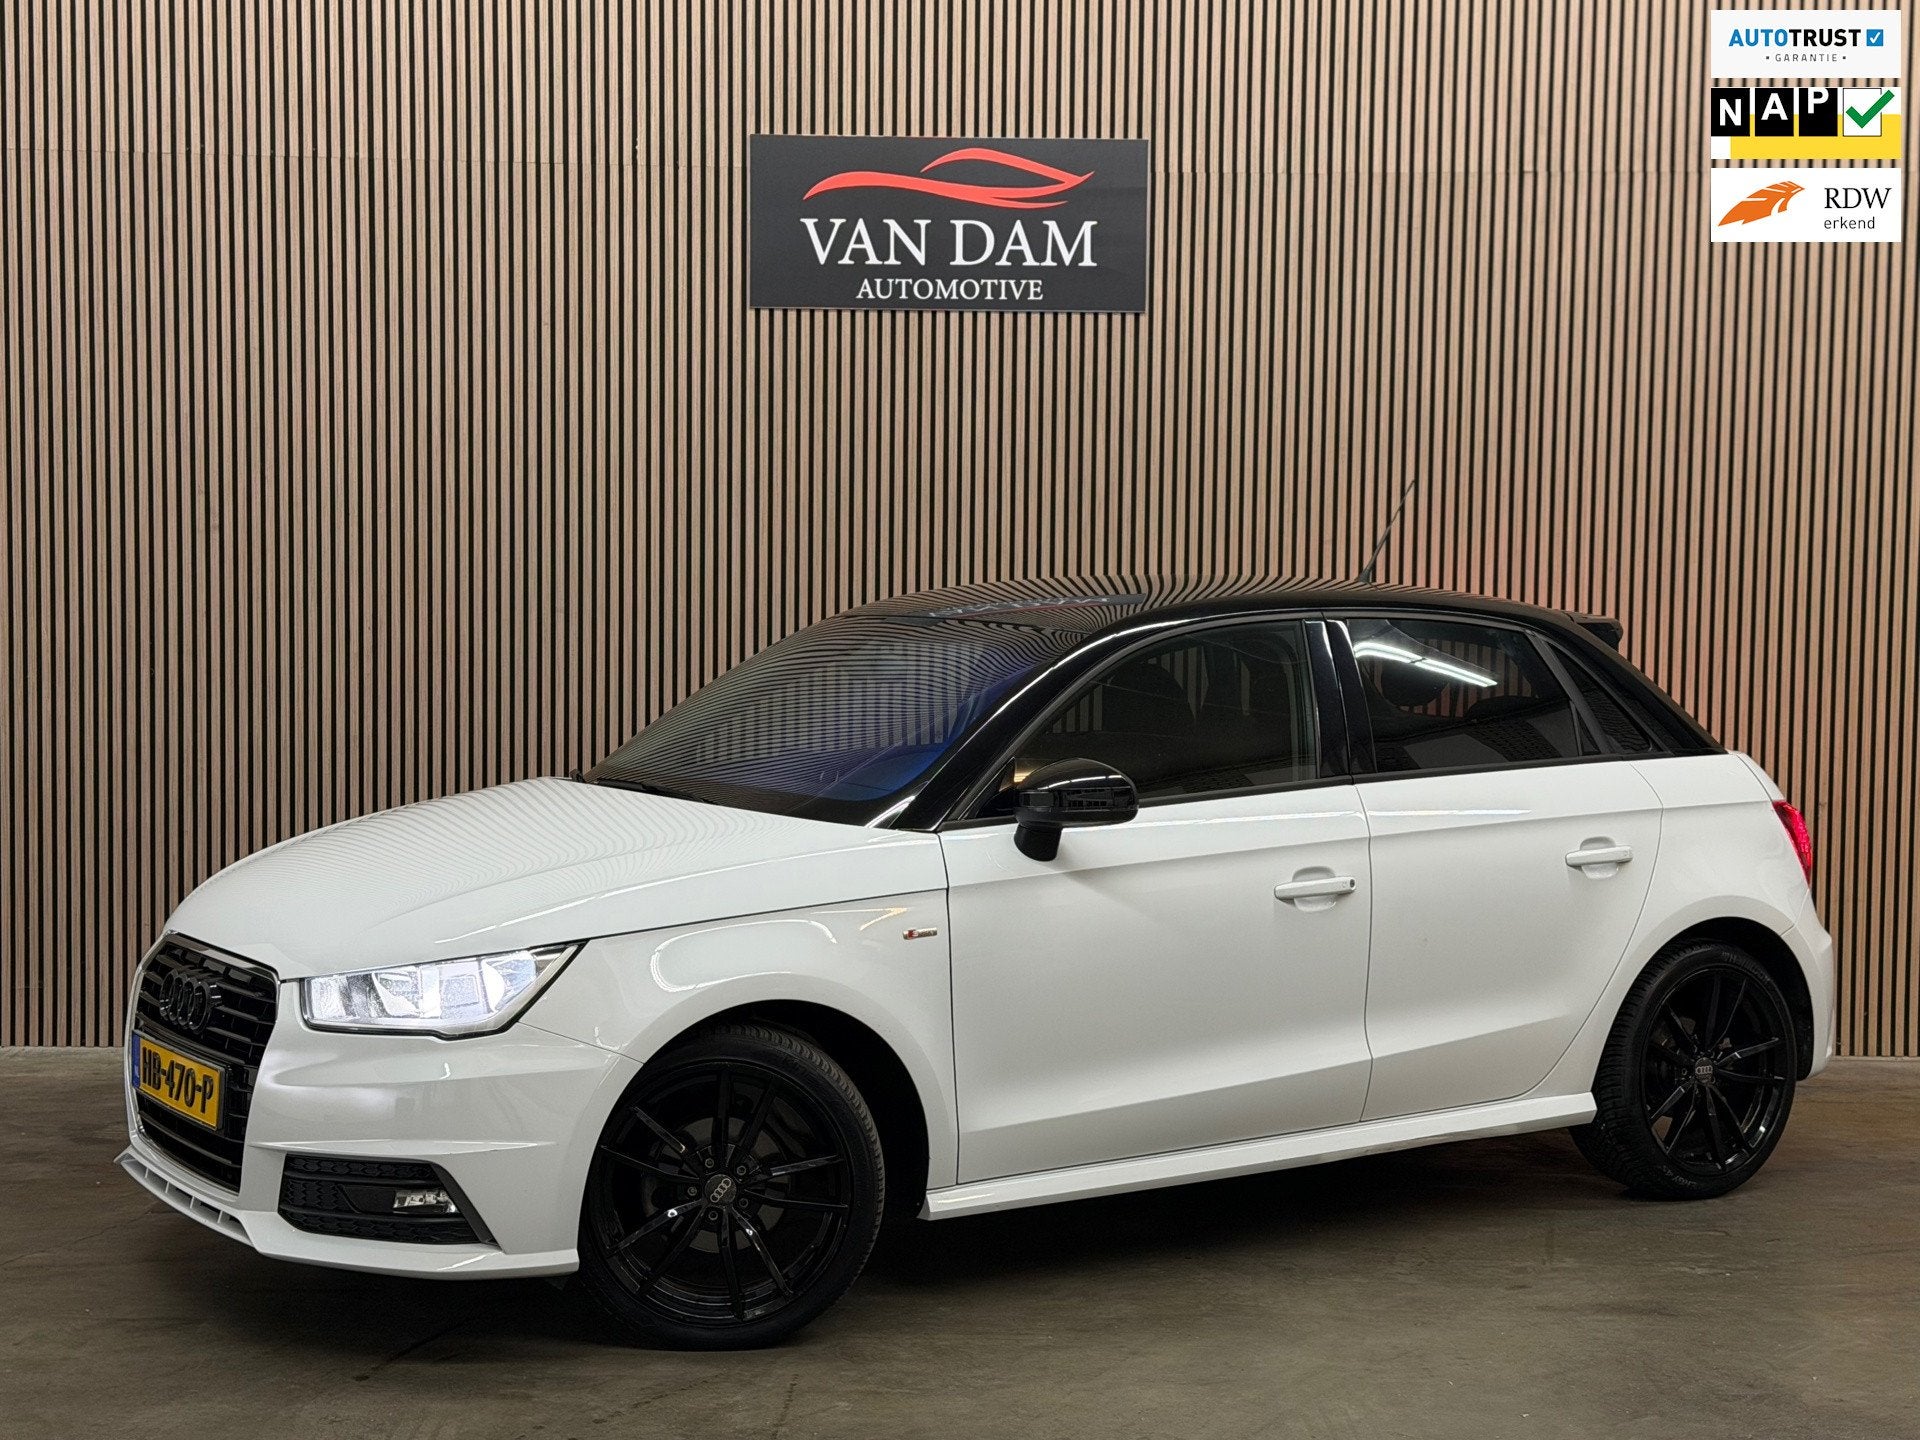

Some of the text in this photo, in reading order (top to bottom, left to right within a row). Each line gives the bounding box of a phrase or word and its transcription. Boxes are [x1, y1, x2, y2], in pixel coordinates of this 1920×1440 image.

[800, 218, 1098, 267] VAN DAM
[856, 278, 1044, 301] AUTOMOTIVE
[142, 1046, 214, 1114] HB-470-P
